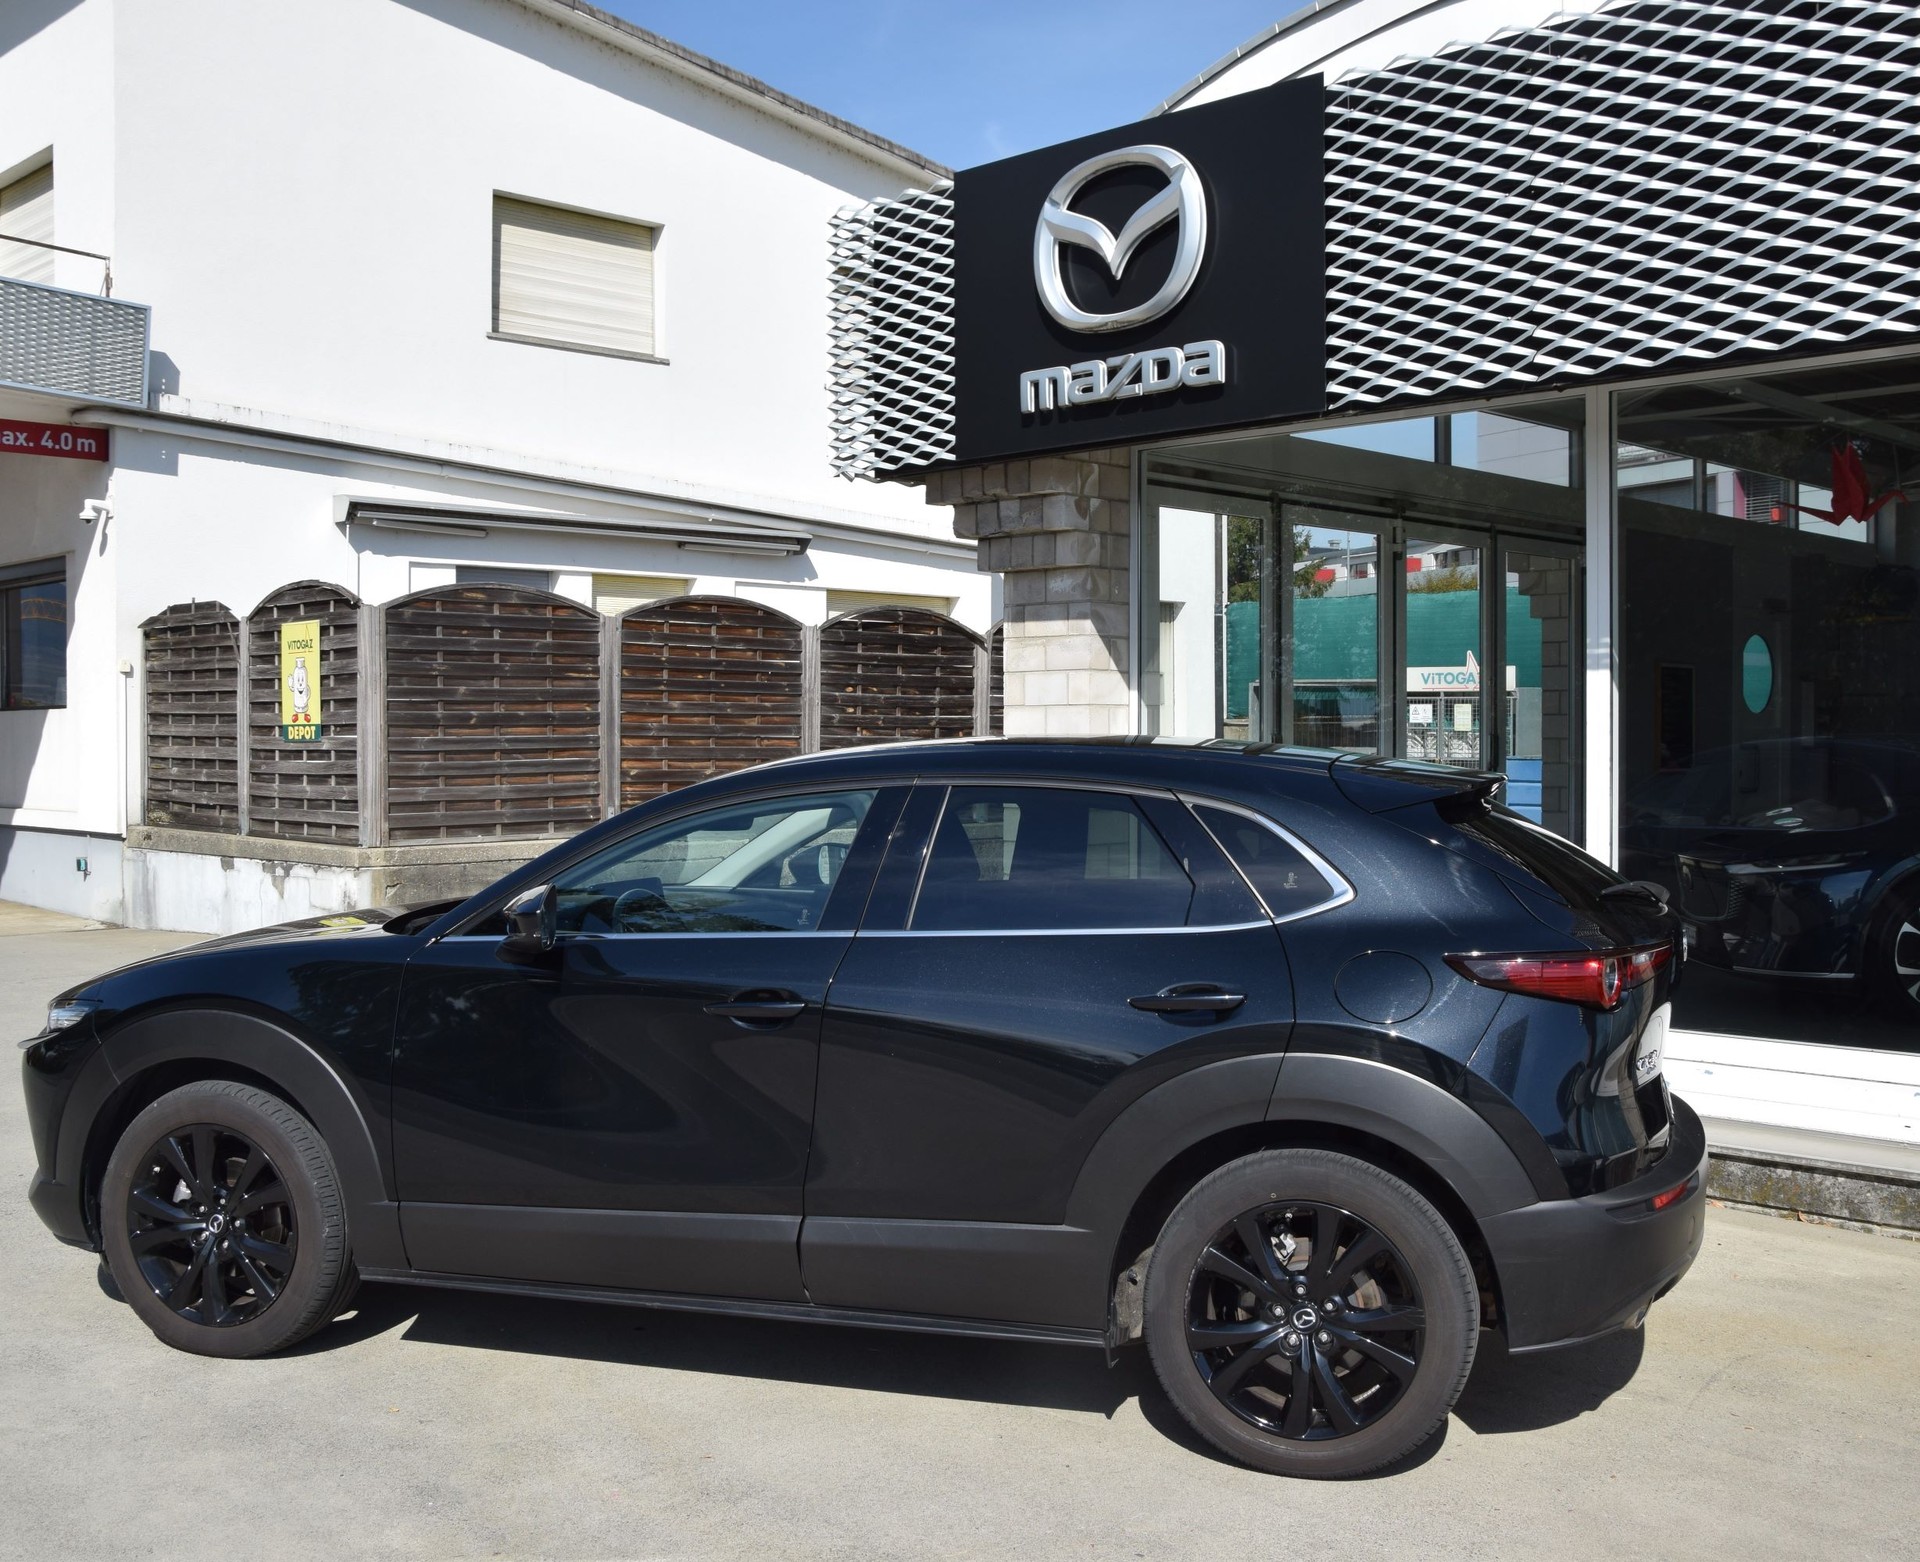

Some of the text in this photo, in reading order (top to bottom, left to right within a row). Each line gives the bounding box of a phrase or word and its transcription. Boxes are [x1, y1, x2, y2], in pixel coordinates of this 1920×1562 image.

[1019, 340, 1226, 414] mazda
[0, 430, 96, 453] ax. 4.0 m
[1421, 672, 1479, 685] ViTOGA
[288, 726, 316, 740] DEPOT
